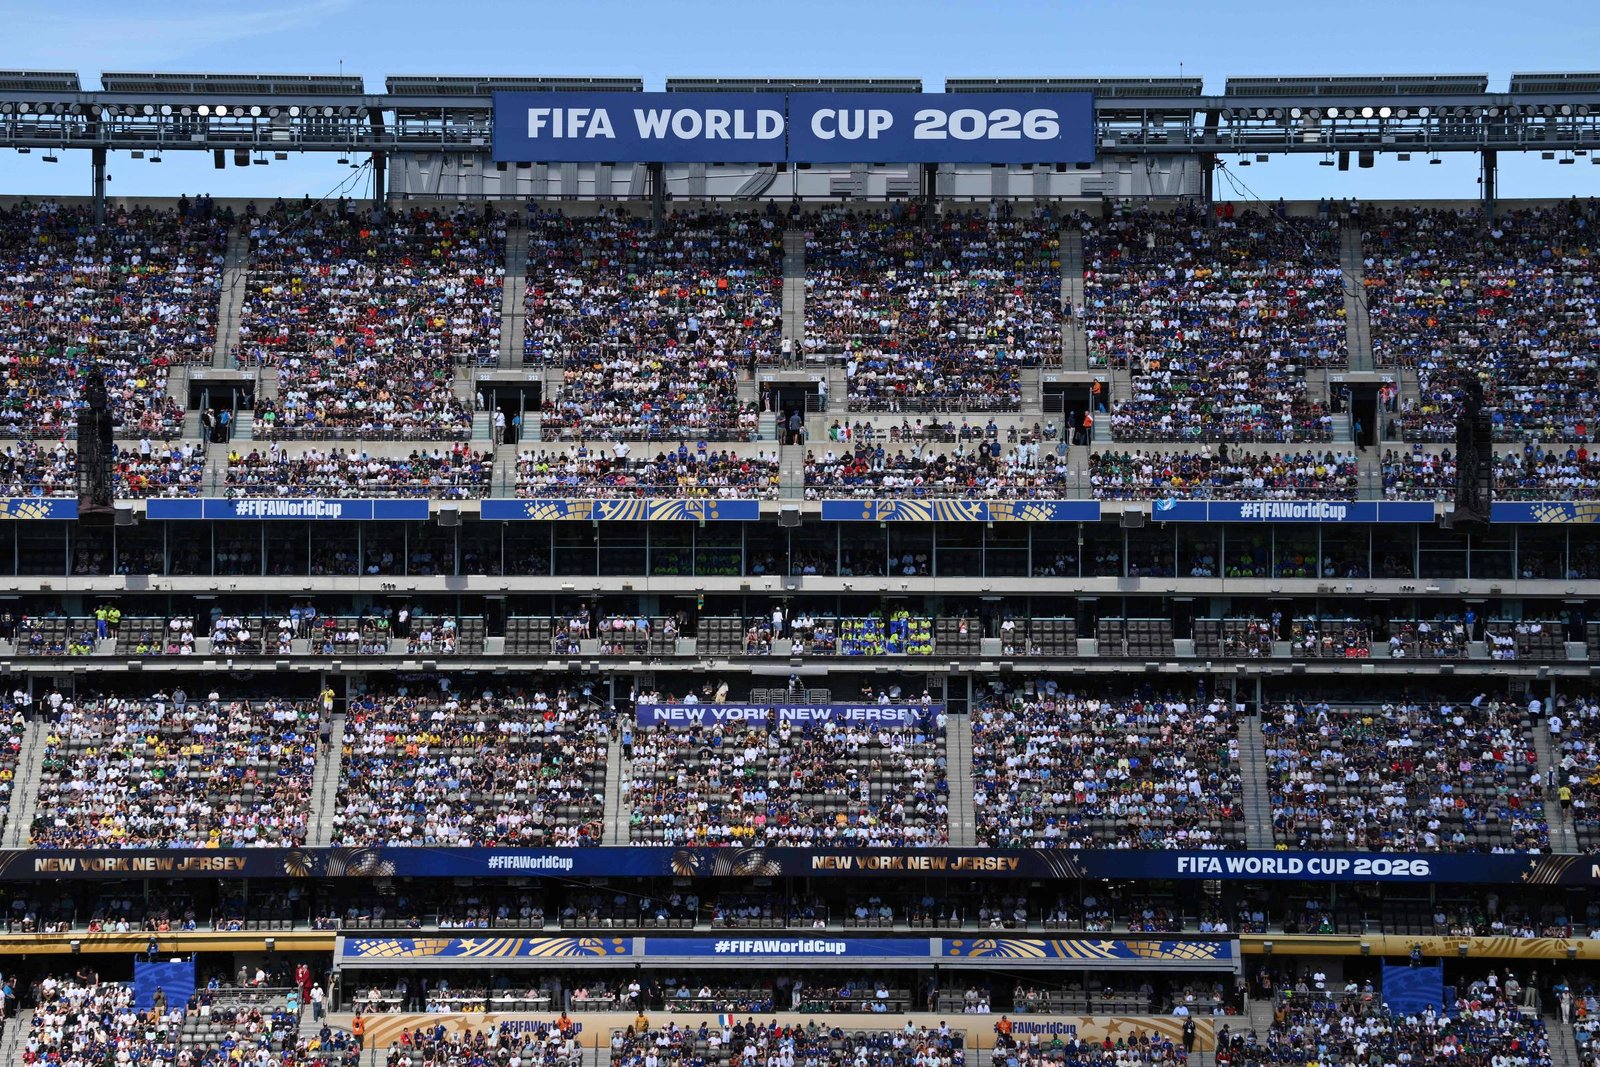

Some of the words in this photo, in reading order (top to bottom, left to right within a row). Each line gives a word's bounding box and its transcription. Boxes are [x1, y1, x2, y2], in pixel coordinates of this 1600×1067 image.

[527, 108, 616, 139] FIFA
[633, 108, 786, 140] WORLD
[811, 108, 894, 140] CUP
[913, 108, 1060, 140] 2026
[236, 500, 342, 519] #FIFAWorldCup
[1240, 502, 1346, 521] #FIFAWorldCup
[653, 708, 706, 720] NEW
[711, 708, 770, 720] YORK
[779, 708, 832, 720] NEW
[34, 857, 77, 872] NEW
[80, 857, 129, 872] YORK
[132, 857, 174, 872] NEW
[177, 857, 247, 872] JERSEY
[488, 855, 574, 871] #FIFAWorldCup
[811, 855, 853, 870] NEW
[855, 855, 904, 870] YORK
[907, 856, 948, 870] NEW
[951, 856, 1020, 871] JERSEY
[1177, 856, 1223, 873] FIFA
[1226, 857, 1304, 874] WORLD
[1307, 857, 1350, 875] CUP
[1353, 858, 1429, 876] 2026
[714, 940, 847, 955] #FIFAWorldCup
